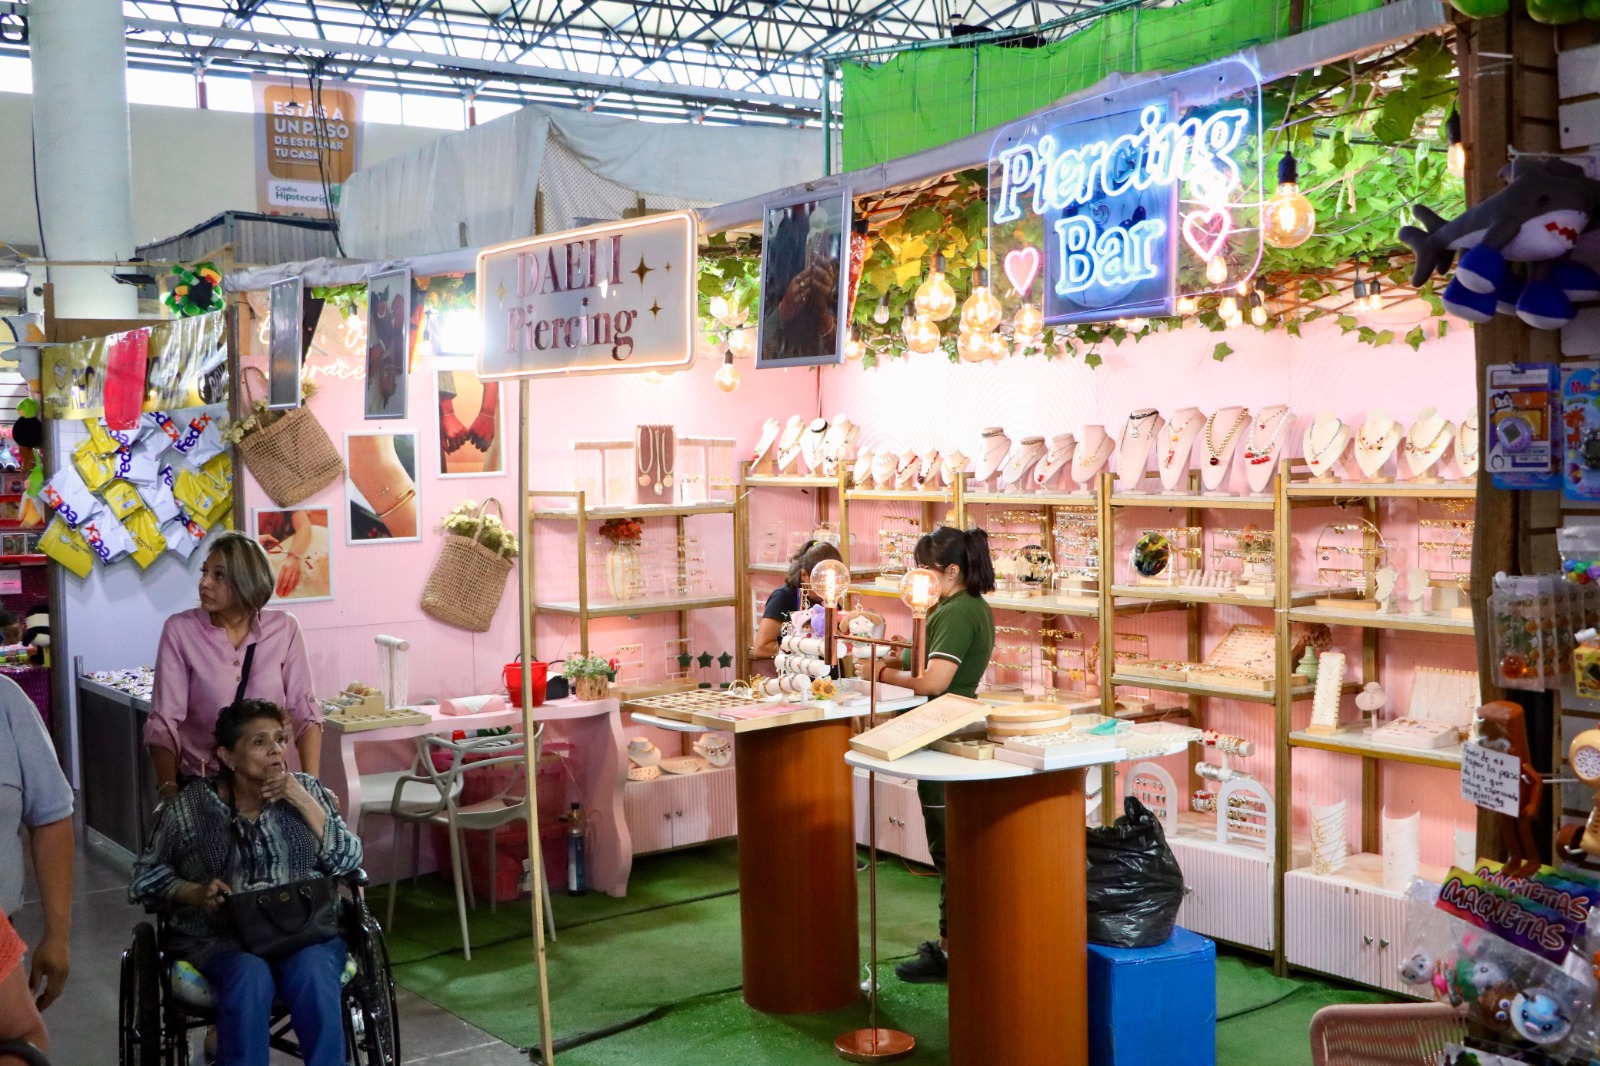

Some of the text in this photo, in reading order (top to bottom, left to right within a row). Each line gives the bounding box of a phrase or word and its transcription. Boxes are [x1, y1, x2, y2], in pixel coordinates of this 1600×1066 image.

[332, 107, 344, 121] A
[274, 118, 299, 134] UN
[275, 136, 288, 145] DE
[275, 148, 319, 159] TU CASA
[994, 106, 1248, 224] Piercing
[275, 192, 327, 203] Hipotecario
[1055, 215, 1166, 295] Bar
[507, 297, 638, 361] Piercing
[175, 412, 212, 453] FedEx
[1487, 763, 1496, 774] la
[1442, 879, 1566, 951] MAQUETAS
